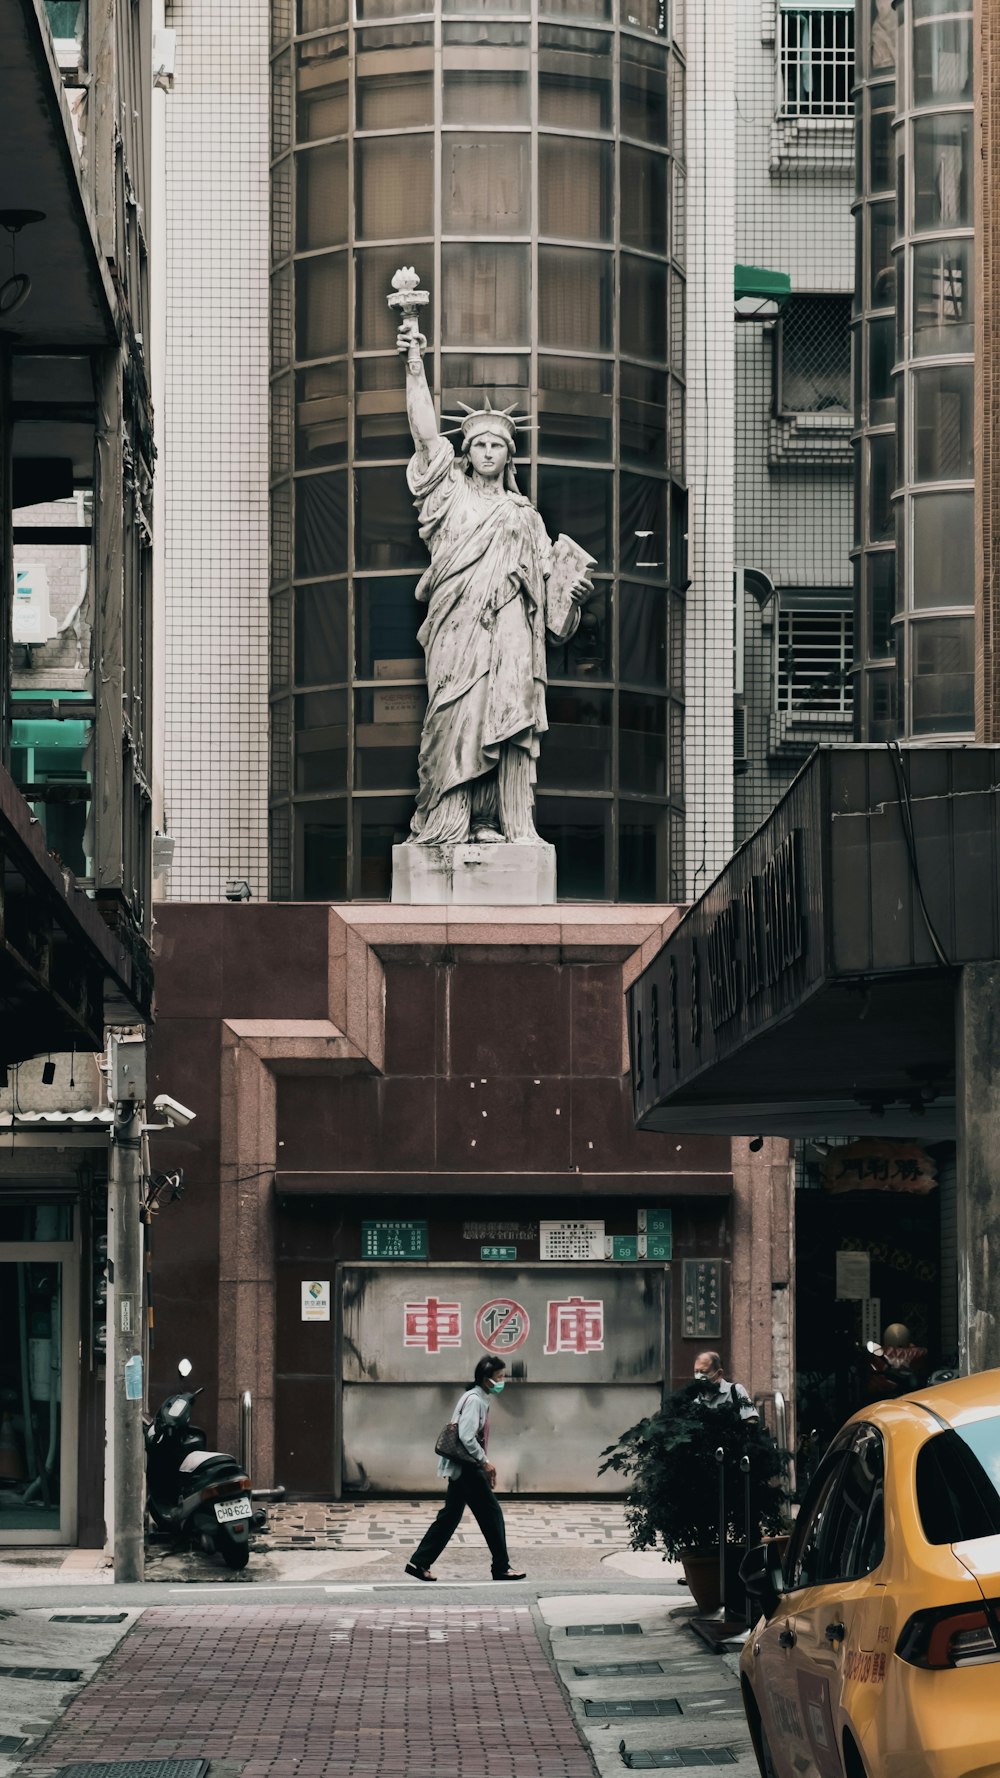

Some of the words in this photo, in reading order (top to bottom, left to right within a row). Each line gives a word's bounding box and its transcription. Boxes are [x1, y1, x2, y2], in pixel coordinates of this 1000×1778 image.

[762, 828, 803, 989] HOTEL
[653, 1221, 665, 1230] 59
[619, 1248, 631, 1257] 59
[653, 1247, 665, 1256] 59
[404, 1296, 462, 1354] 車
[543, 1296, 604, 1354] 庫
[217, 1504, 251, 1520] CHQ-622
